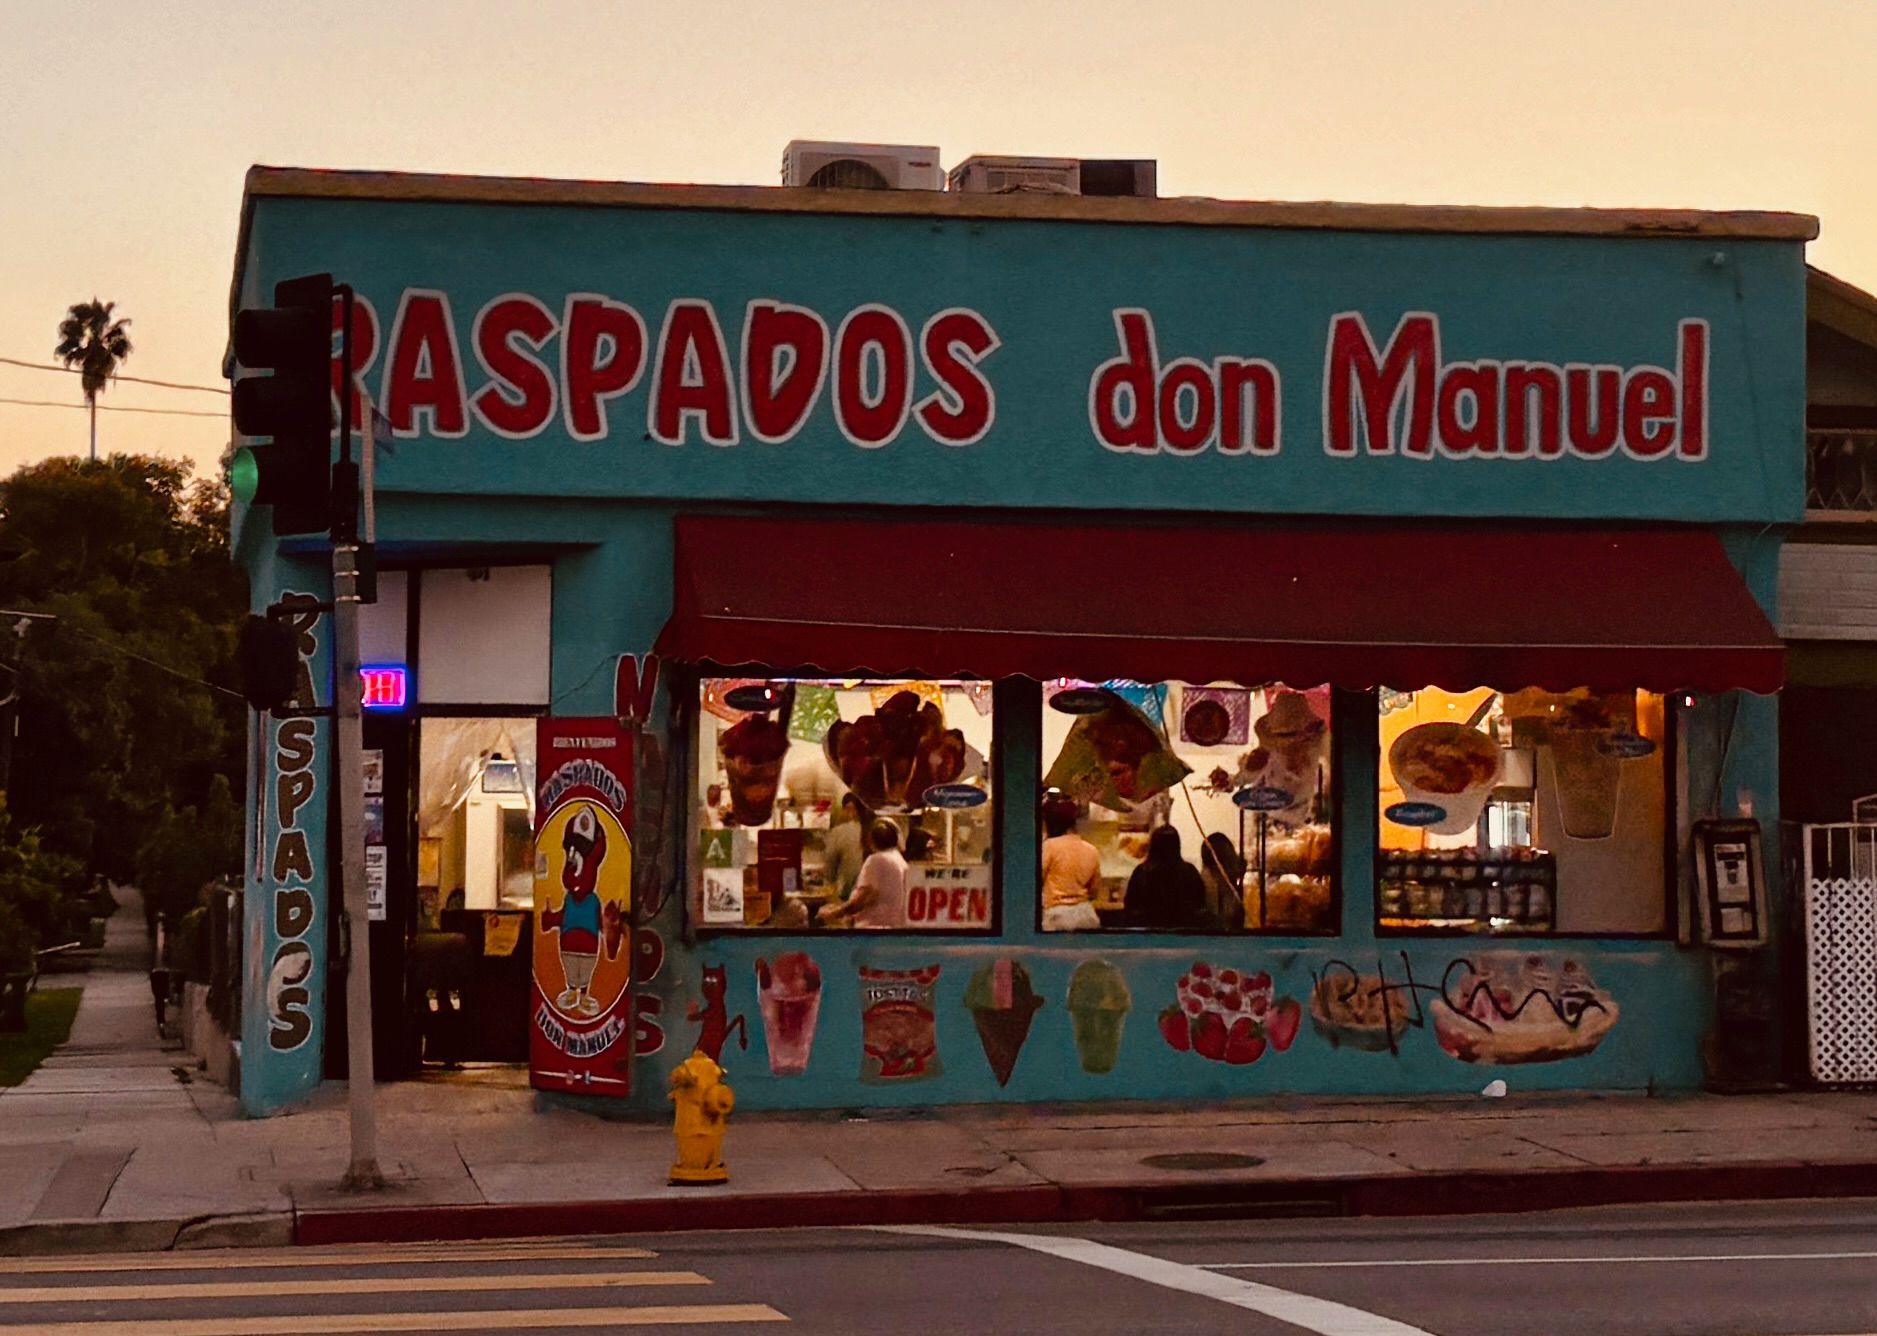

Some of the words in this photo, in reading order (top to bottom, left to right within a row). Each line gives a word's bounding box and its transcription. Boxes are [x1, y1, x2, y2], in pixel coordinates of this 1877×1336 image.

[1088, 307, 1281, 456] don
[1322, 310, 1711, 462] Manuel
[705, 837, 726, 860] A
[907, 886, 987, 921] OPEN
